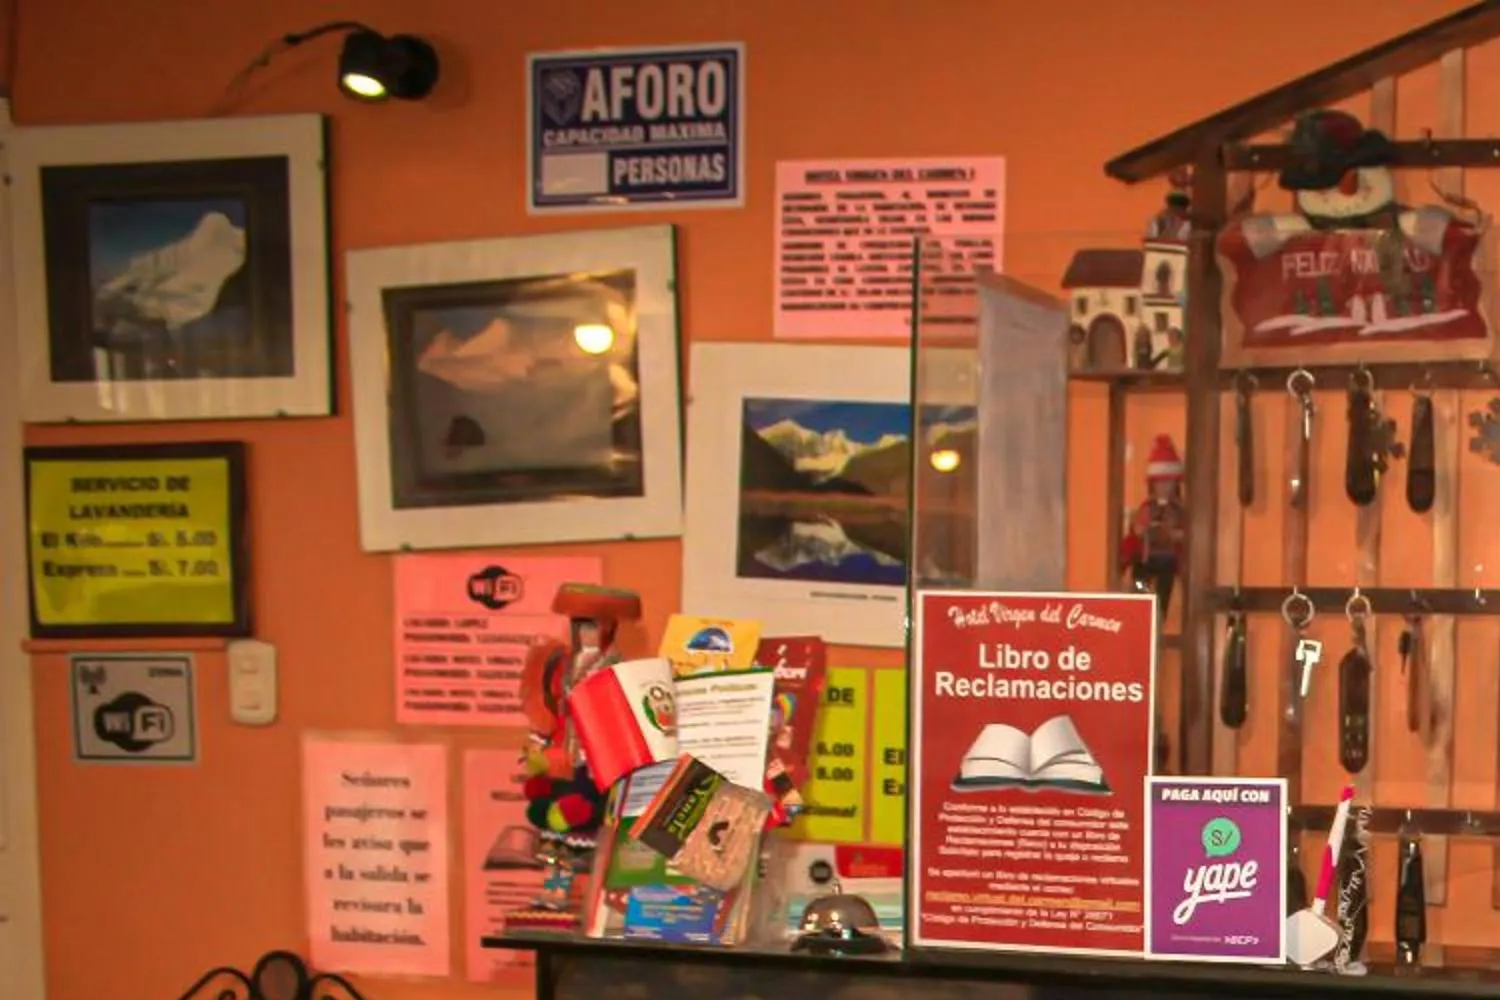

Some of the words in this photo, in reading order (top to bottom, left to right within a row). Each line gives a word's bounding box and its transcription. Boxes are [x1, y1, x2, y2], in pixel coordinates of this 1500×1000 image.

[580, 60, 726, 122] AFORO
[543, 125, 644, 146] CAPACIDAD
[613, 153, 725, 185] PERSONAS
[166, 475, 190, 491] DE
[948, 605, 990, 628] Hotel
[990, 601, 1035, 629] Virgen
[1040, 604, 1063, 624] del
[1066, 603, 1123, 634] Carmen
[979, 643, 1049, 669] Libro
[1058, 645, 1091, 671] de
[827, 687, 855, 703] DE
[935, 671, 1144, 703] Reclamaciones
[342, 772, 411, 788] Señores
[1162, 788, 1200, 801] PAGA
[1202, 787, 1239, 802] AQUÍ
[1241, 789, 1270, 803] CON
[324, 805, 404, 822] pasajeros
[339, 864, 354, 880] la
[360, 866, 408, 883] salida
[1173, 859, 1258, 925] yape
[408, 898, 423, 915] la
